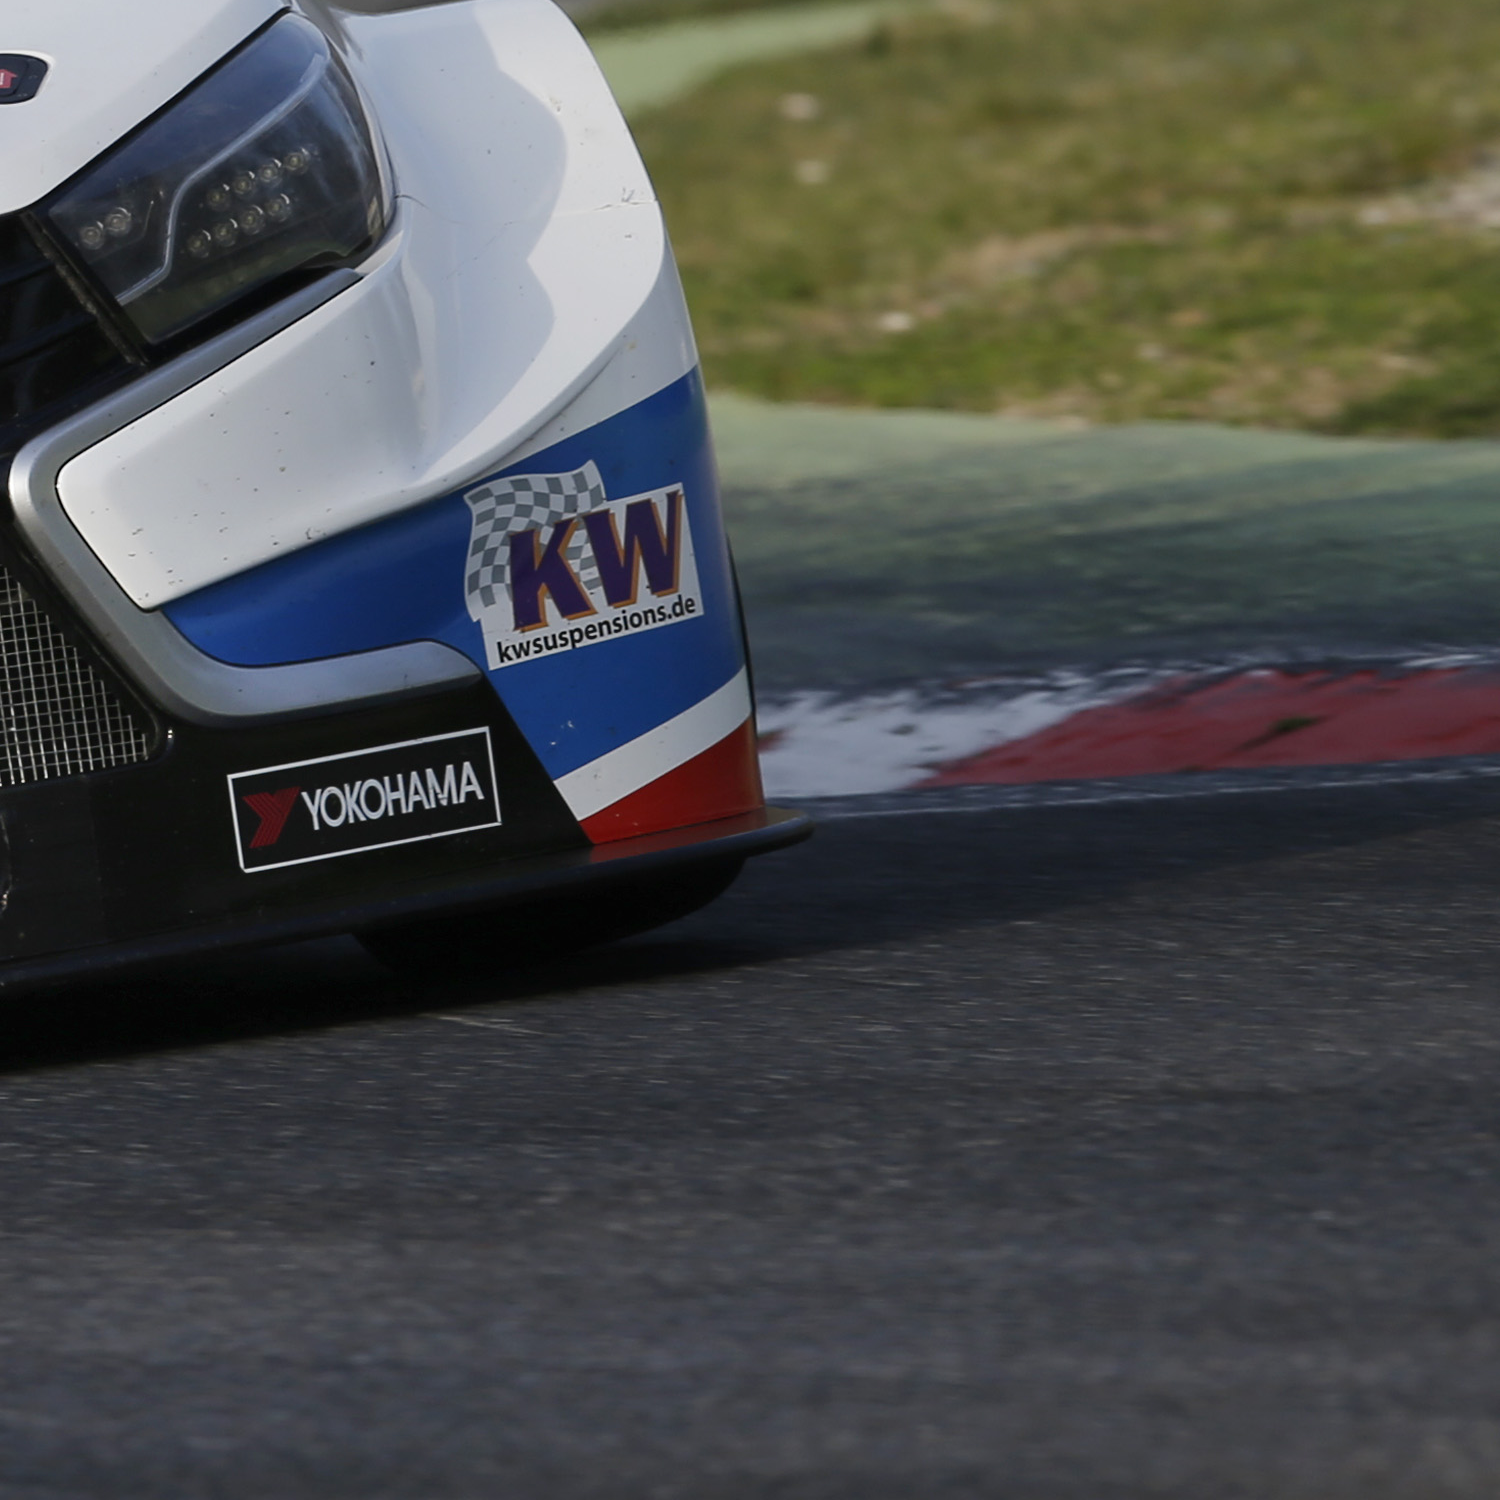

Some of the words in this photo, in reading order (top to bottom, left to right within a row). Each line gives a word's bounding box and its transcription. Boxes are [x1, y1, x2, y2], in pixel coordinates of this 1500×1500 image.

[508, 489, 685, 633] KW
[497, 594, 697, 664] kwsuspensions.de
[301, 761, 485, 831] YOKOHAMA
